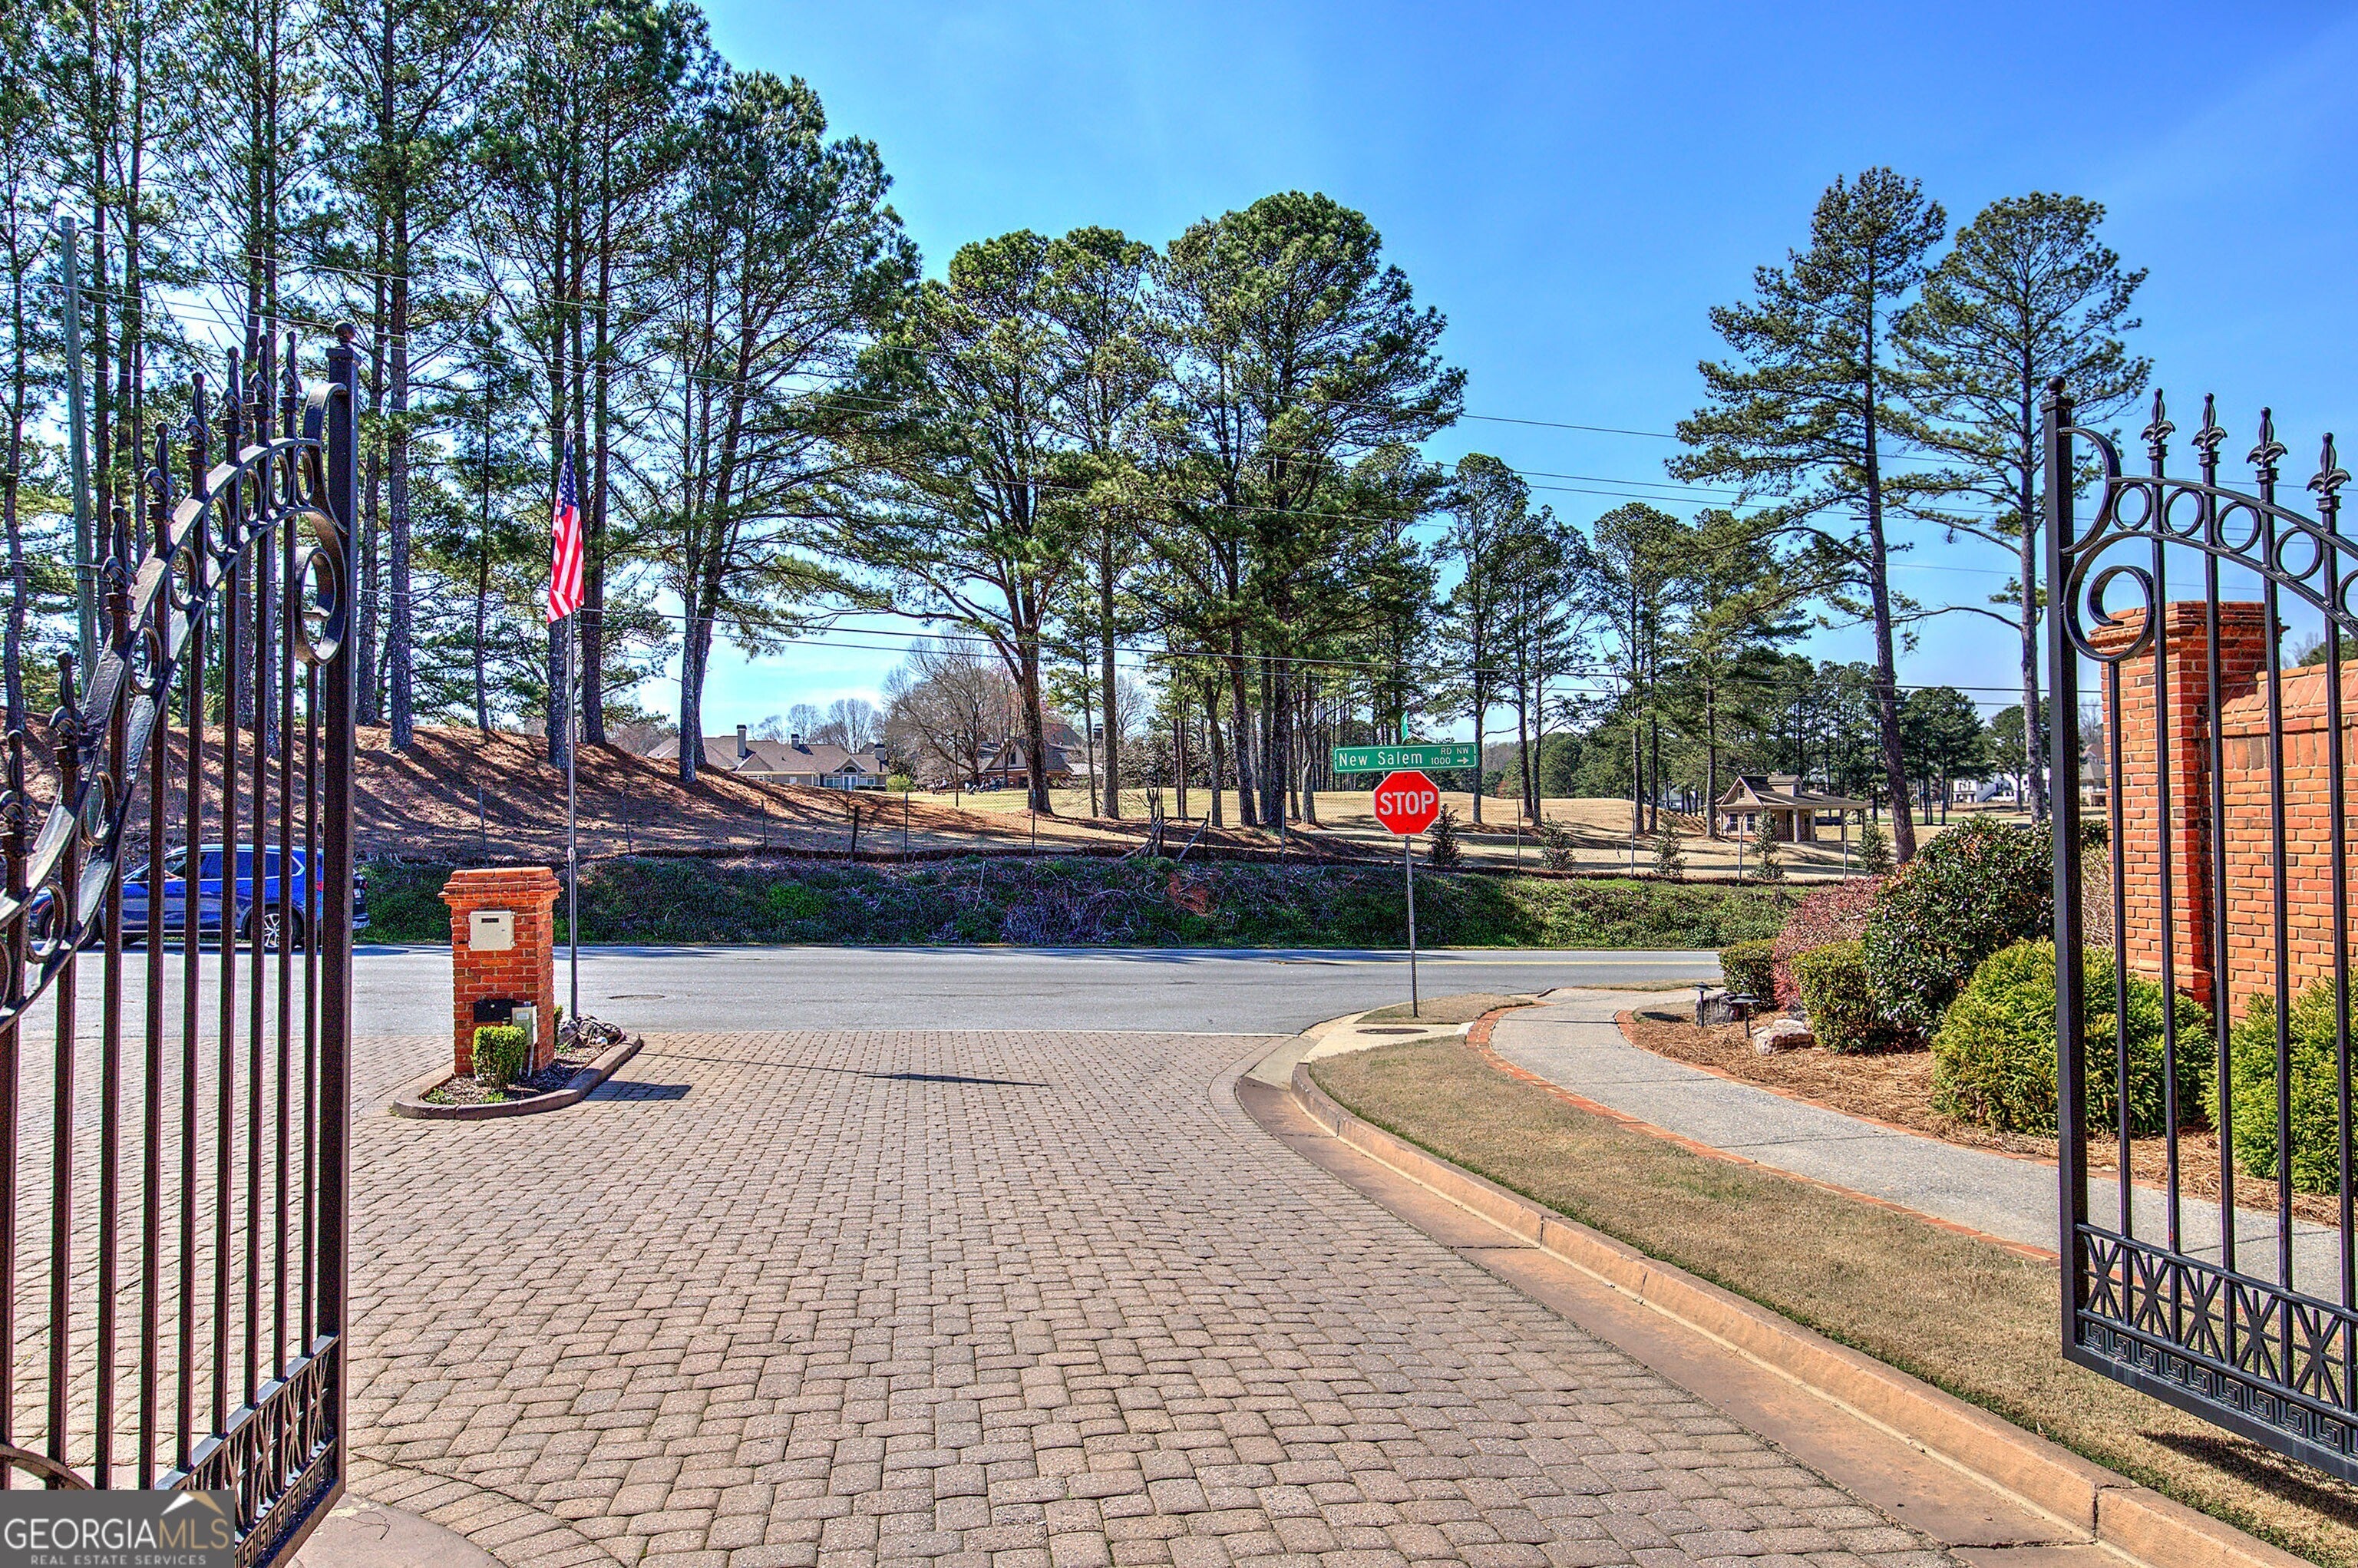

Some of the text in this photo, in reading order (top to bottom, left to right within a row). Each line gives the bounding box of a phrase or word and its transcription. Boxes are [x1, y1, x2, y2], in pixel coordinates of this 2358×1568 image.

[1339, 751, 1423, 767] New Salem
[1431, 757, 1451, 765] 1000
[1379, 791, 1435, 816] STOP
